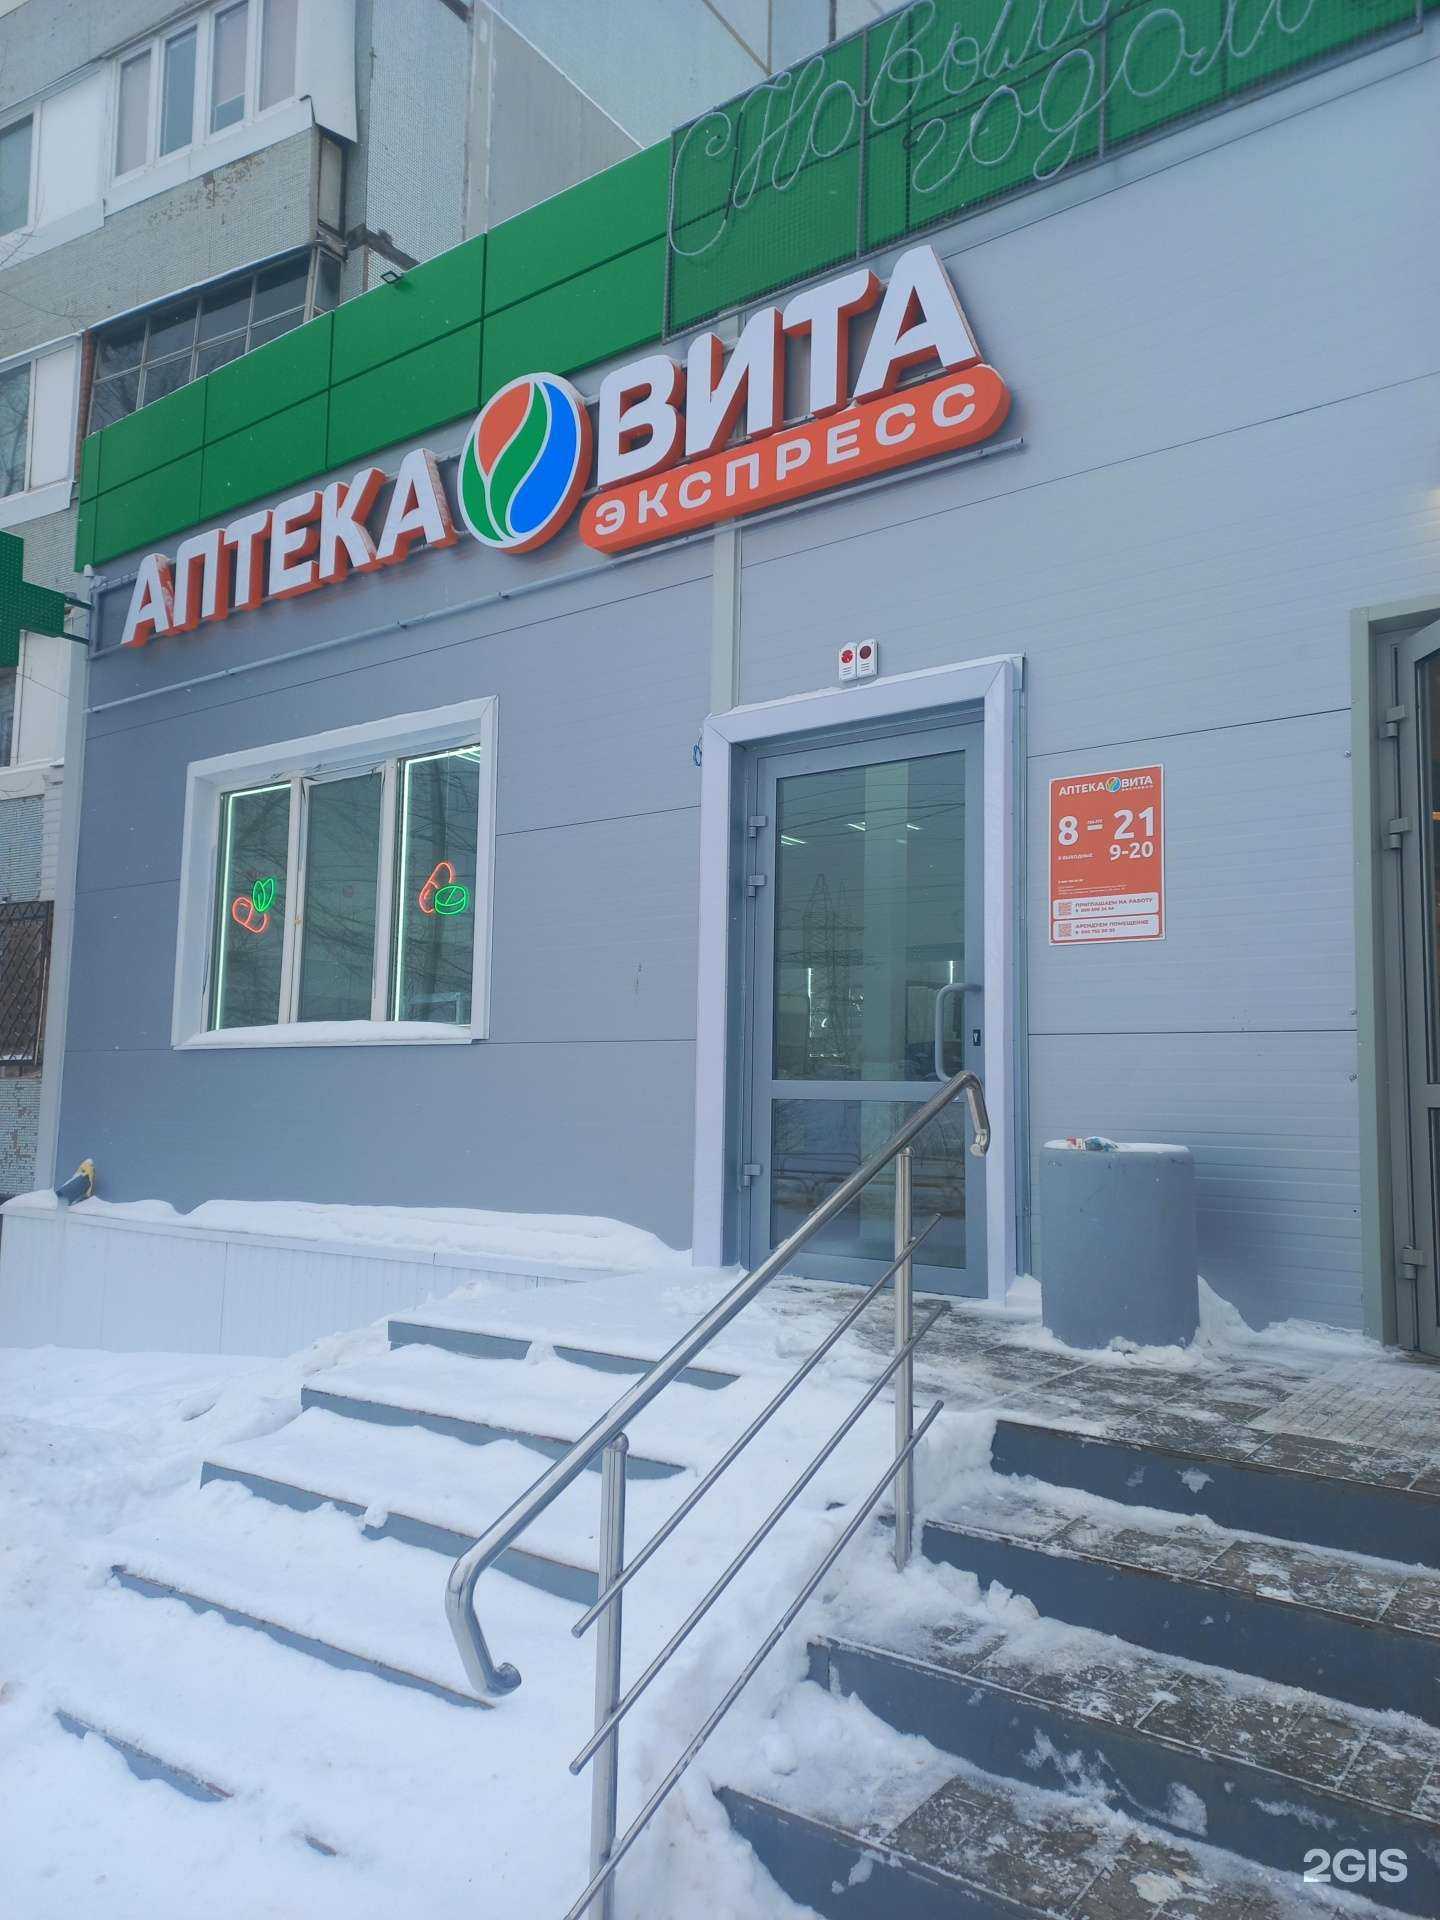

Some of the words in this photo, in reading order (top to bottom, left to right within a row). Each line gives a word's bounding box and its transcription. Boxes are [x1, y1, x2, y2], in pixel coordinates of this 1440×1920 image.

[121, 447, 455, 646] АПТЕКА
[597, 244, 978, 487] ВИТА
[594, 383, 976, 536] ЭКСПРЕСС
[1059, 782, 1106, 796] АПТЕКА
[1121, 775, 1153, 788] ВИТА
[1058, 815, 1079, 846] 8
[1113, 806, 1154, 840] 21
[1109, 841, 1154, 860] 9-20
